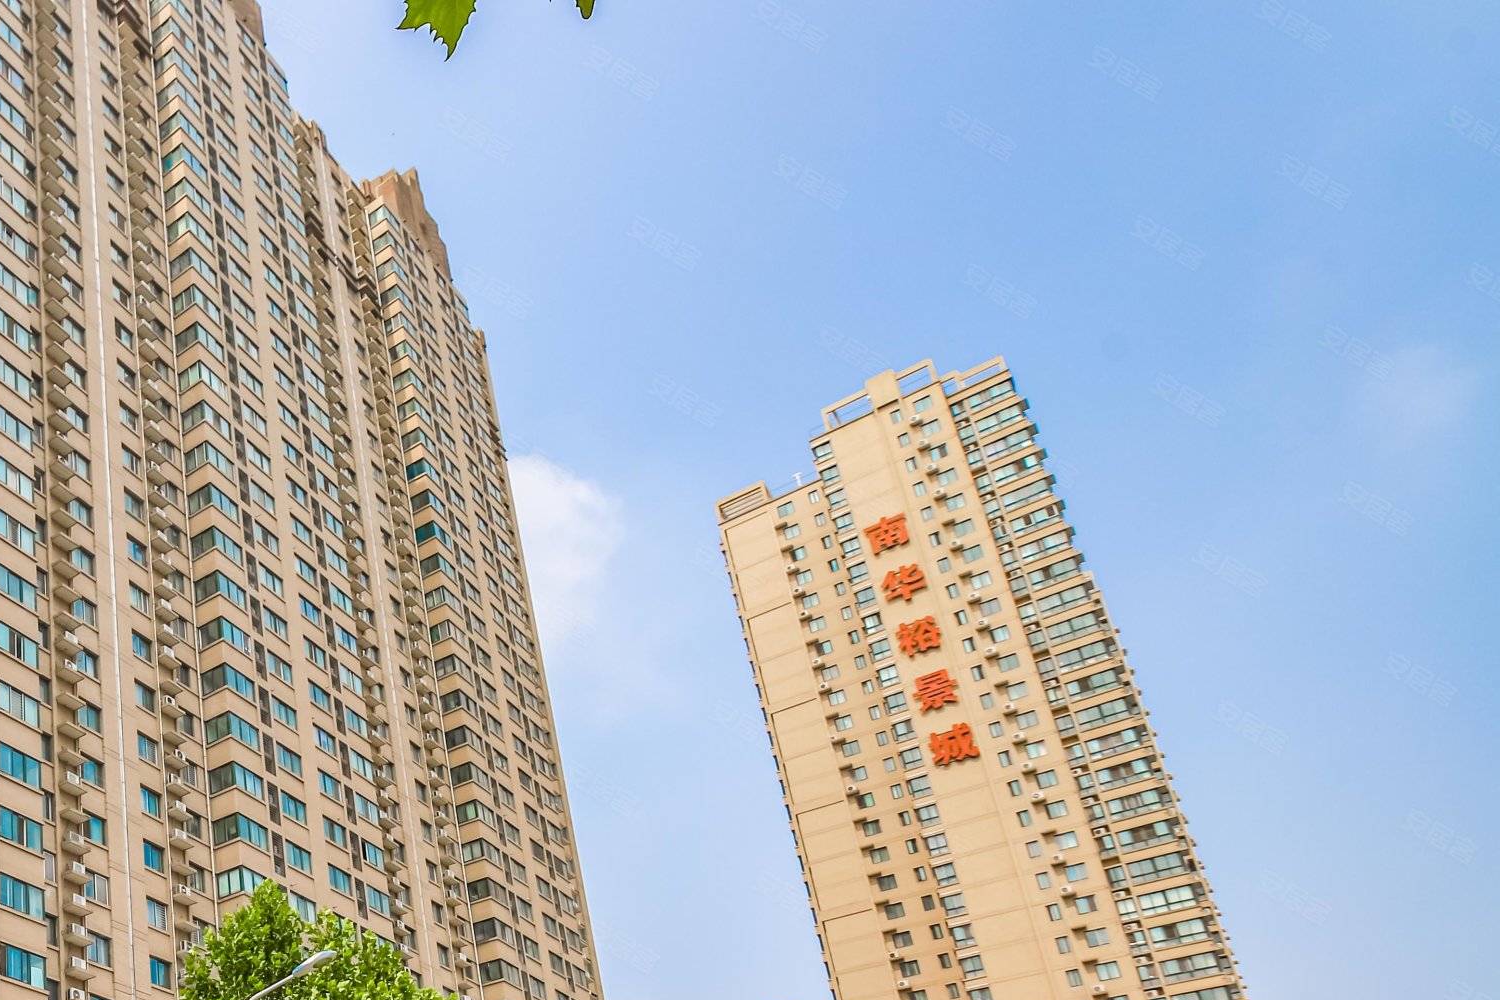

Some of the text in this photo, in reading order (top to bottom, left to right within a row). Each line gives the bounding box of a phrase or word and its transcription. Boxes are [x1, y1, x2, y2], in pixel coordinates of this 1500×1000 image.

[863, 512, 980, 767] 南华裕景城
